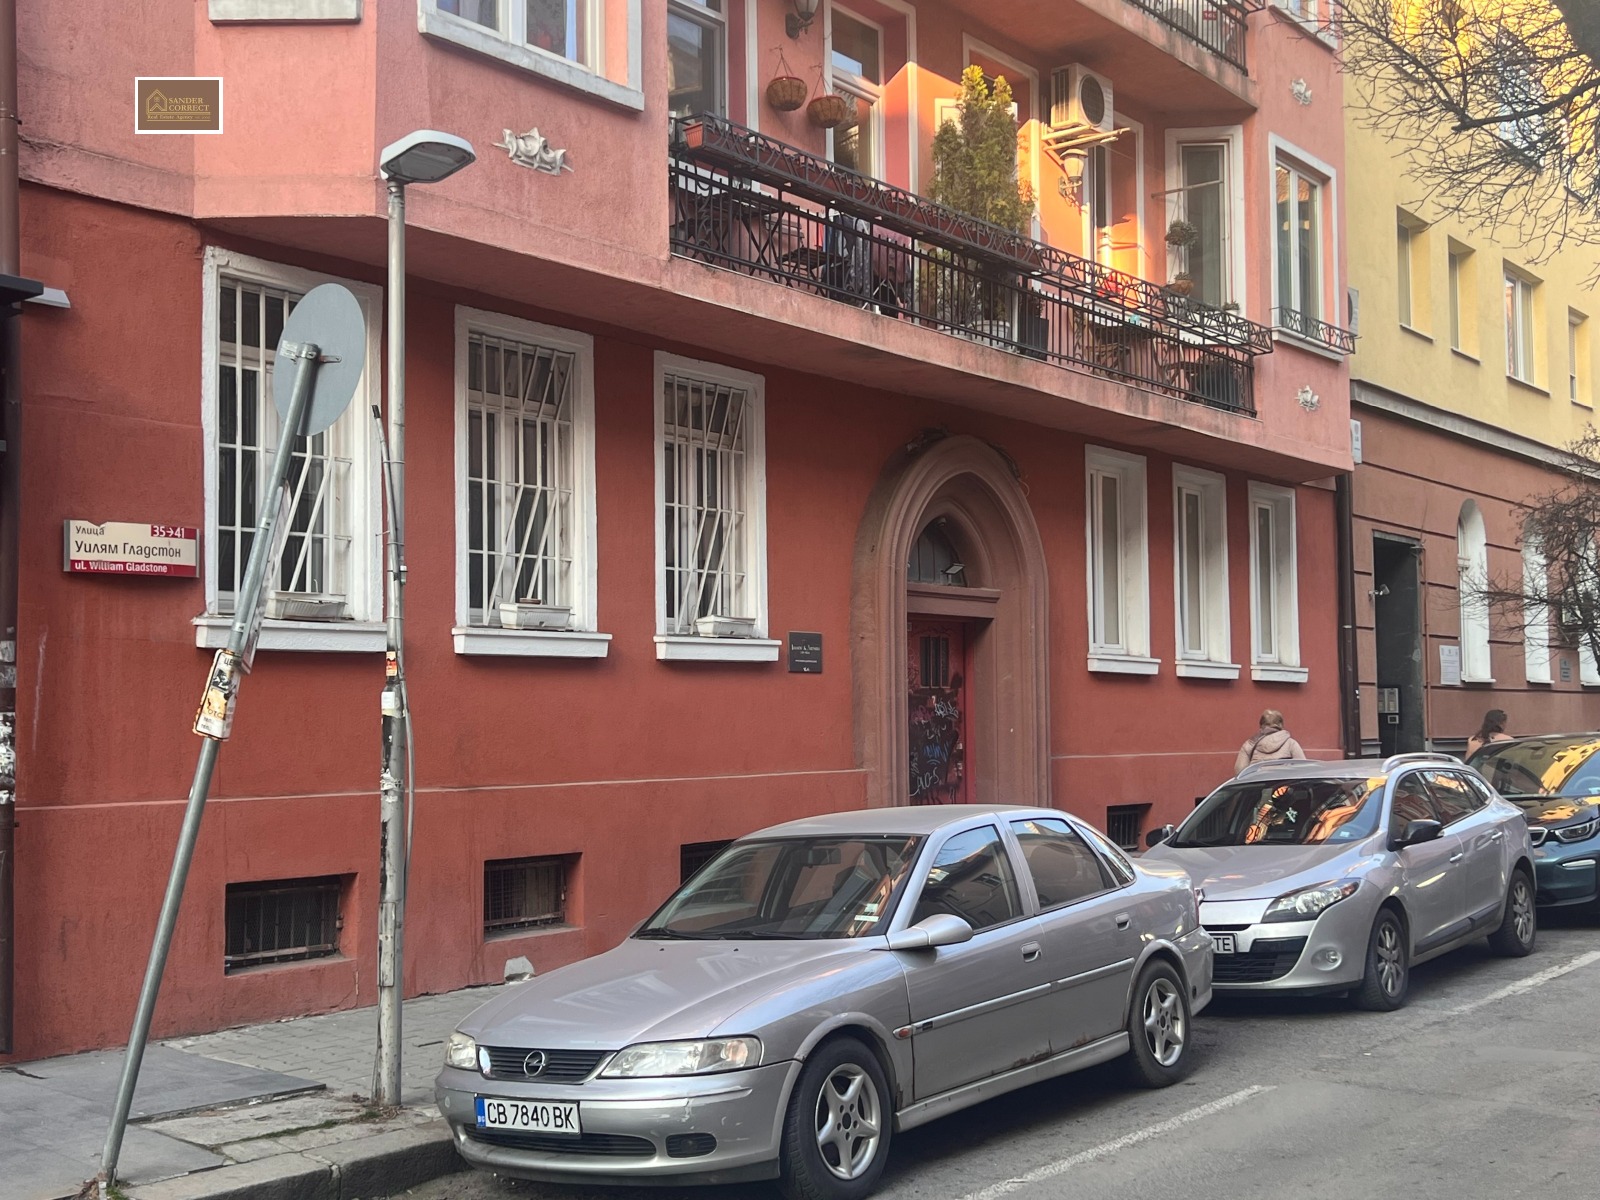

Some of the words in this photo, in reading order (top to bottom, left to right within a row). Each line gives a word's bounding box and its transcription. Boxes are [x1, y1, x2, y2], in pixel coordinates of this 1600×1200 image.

[75, 525, 105, 536] Улица
[74, 540, 119, 555] Уилям
[122, 542, 181, 559] Гладстон
[89, 561, 124, 571] William
[125, 562, 168, 573] Gladstone
[1213, 937, 1232, 952] TE
